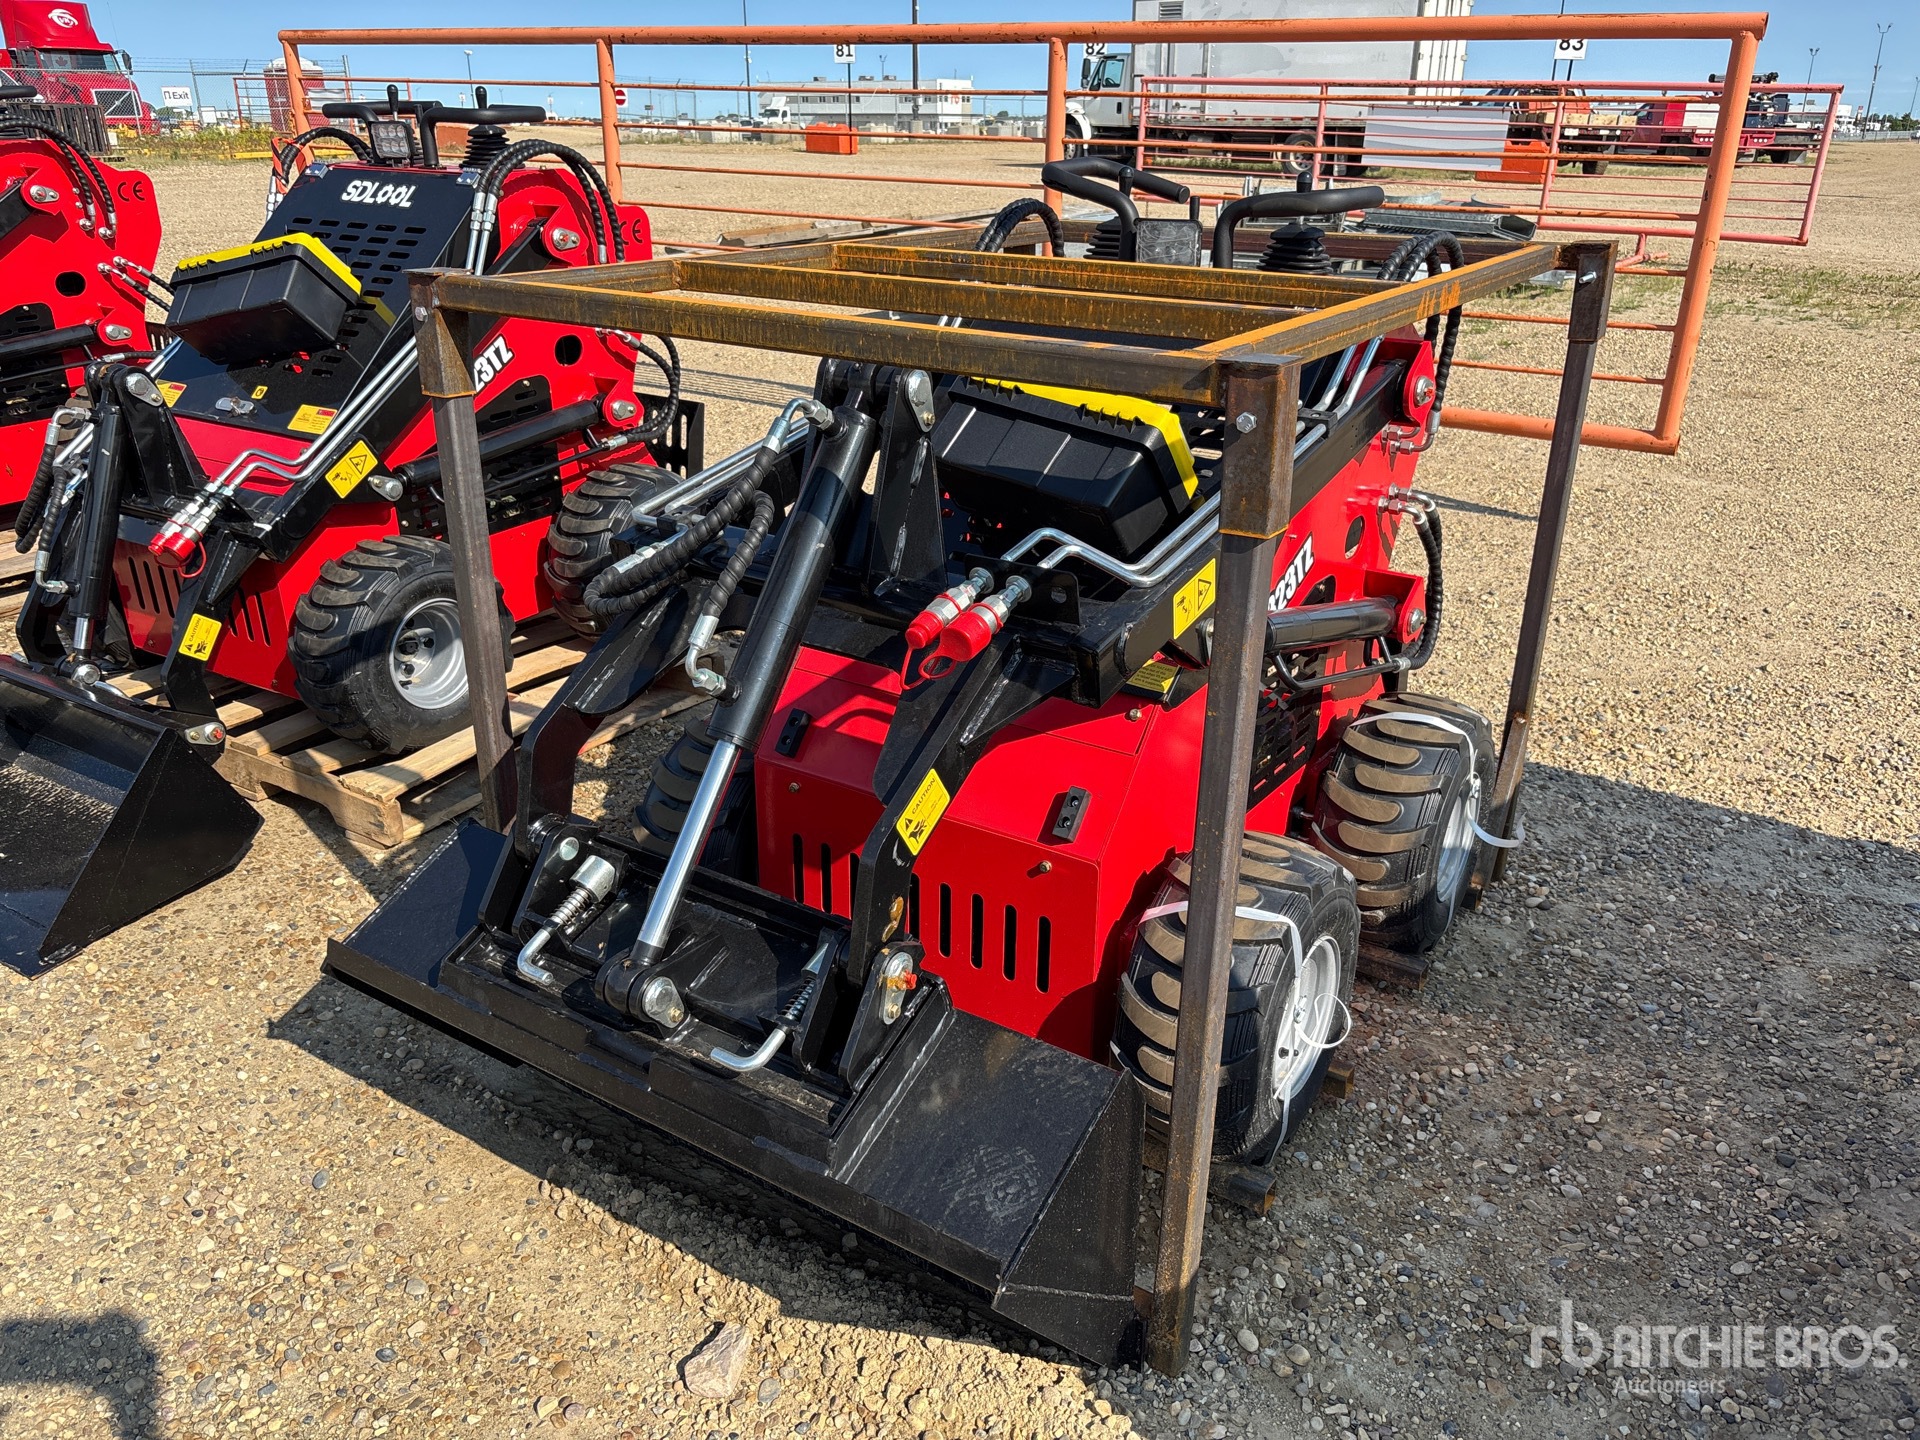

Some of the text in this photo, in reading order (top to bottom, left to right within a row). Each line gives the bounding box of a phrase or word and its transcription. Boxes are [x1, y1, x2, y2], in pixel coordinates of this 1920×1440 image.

[836, 44, 853, 57] 81
[1085, 43, 1105, 55] 82
[1559, 39, 1583, 51] 83
[172, 91, 190, 100] Exit
[117, 181, 146, 202] CE
[189, 617, 202, 642] CAUTION
[911, 777, 936, 815] CAUTION
